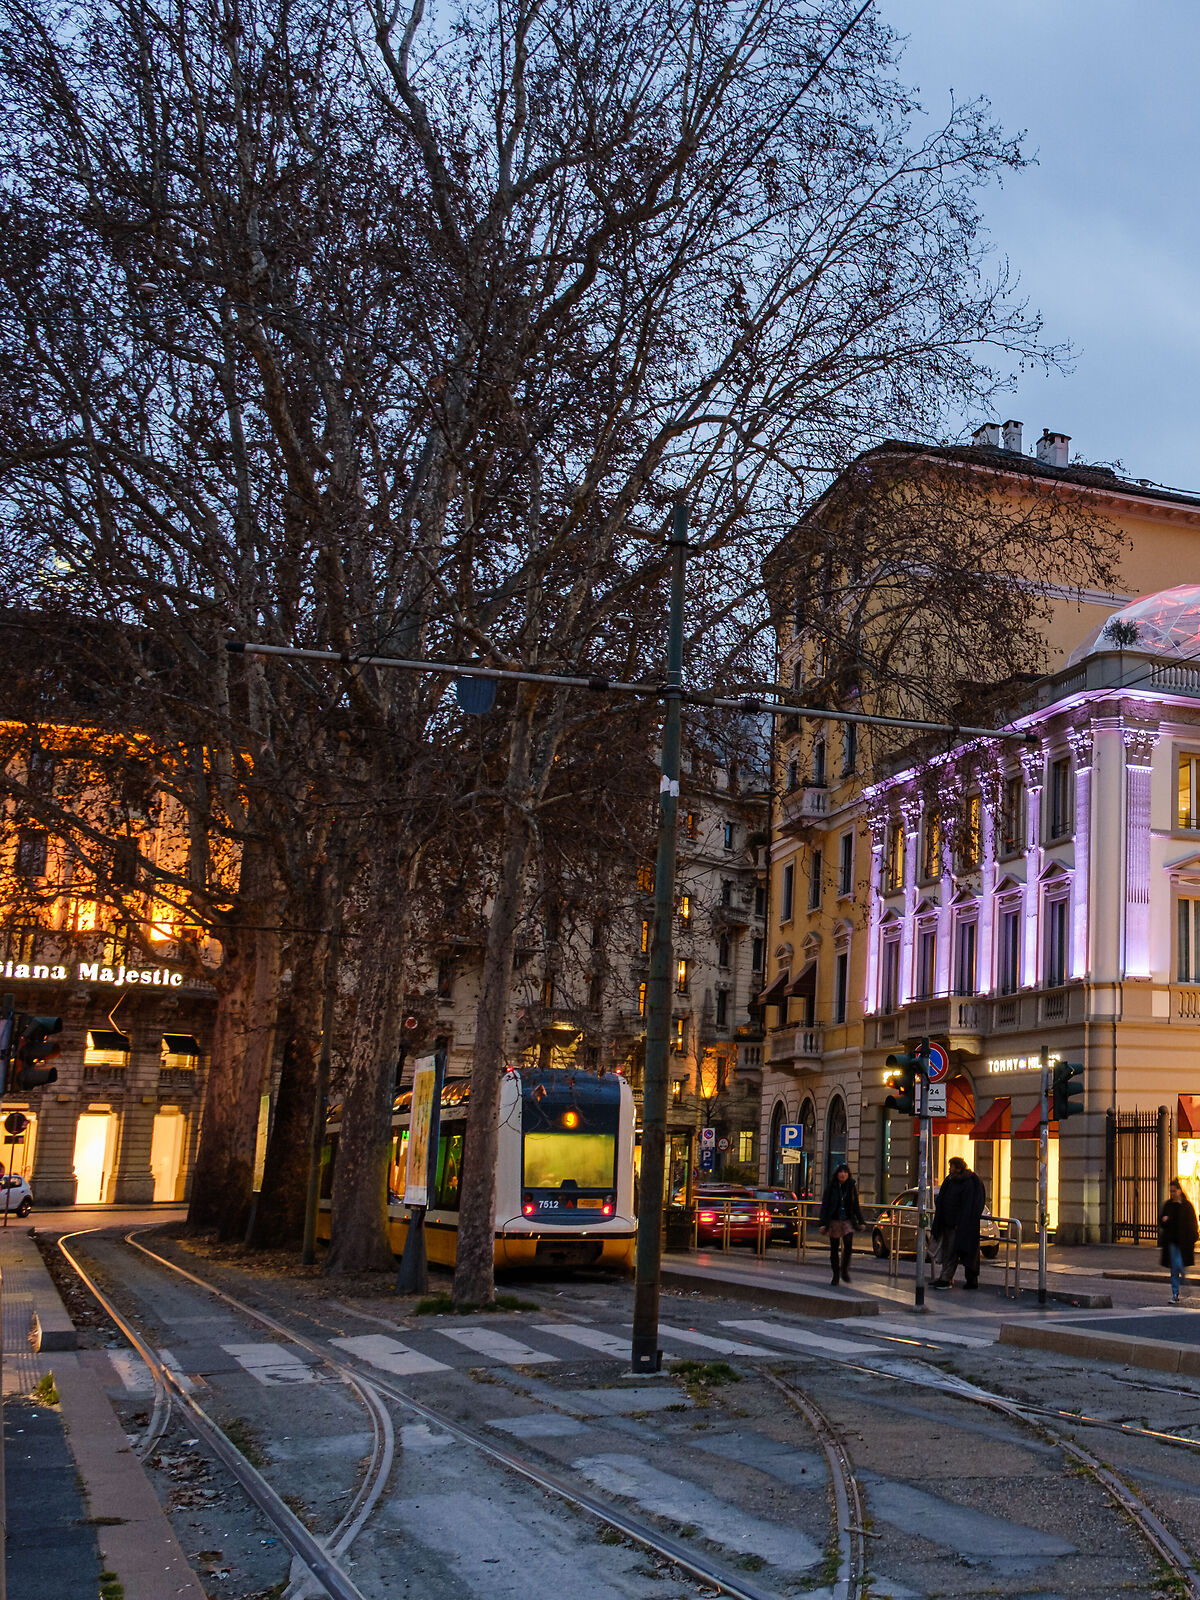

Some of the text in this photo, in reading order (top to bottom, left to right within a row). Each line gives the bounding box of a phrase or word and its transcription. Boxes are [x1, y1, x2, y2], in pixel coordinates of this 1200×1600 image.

[0, 960, 183, 986] iana Majestic
[988, 1058, 1019, 1072] TOMMY
[563, 1111, 577, 1128] 9
[784, 1127, 798, 1145] P
[703, 1151, 711, 1161] P
[539, 1200, 559, 1209] 7512
